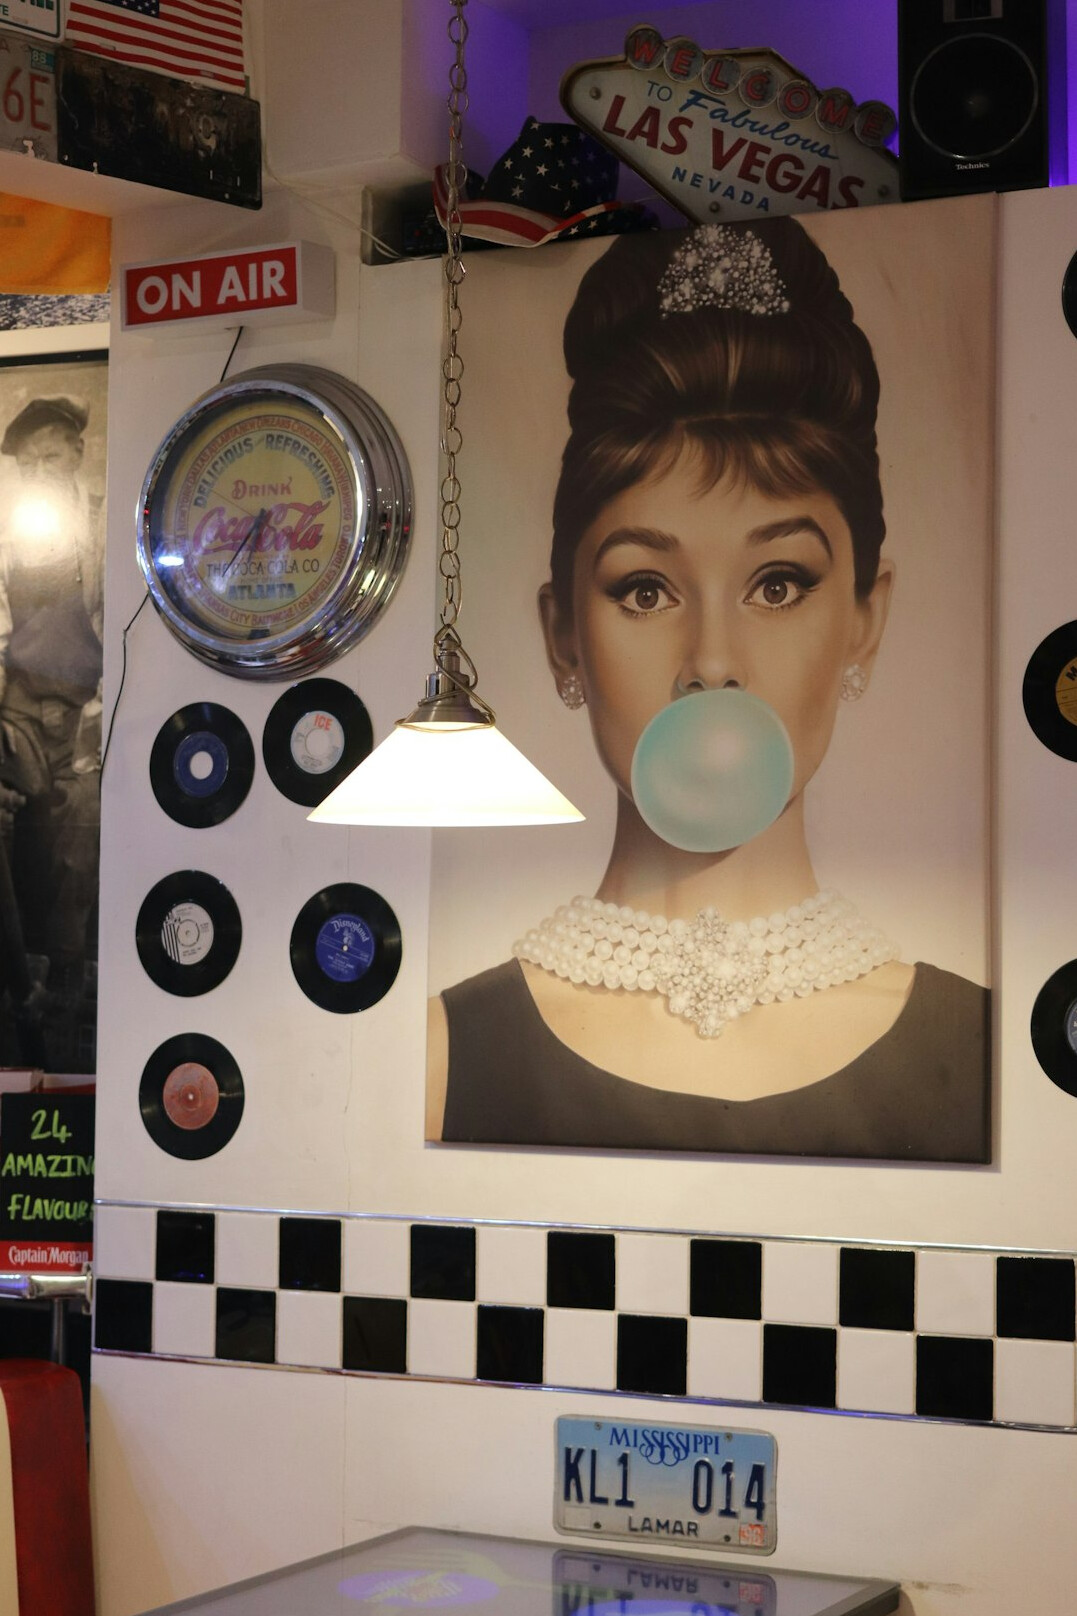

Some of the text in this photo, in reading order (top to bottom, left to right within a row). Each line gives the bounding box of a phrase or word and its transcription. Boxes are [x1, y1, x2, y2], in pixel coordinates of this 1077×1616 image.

[633, 35, 887, 142] WELCOME
[647, 80, 840, 160] TO Fabulous
[602, 95, 865, 210] LAS VEGAS
[954, 161, 991, 171] Technics
[672, 166, 770, 212] NEVADA
[136, 259, 288, 315] ON AIR
[195, 434, 335, 508] DELICIOUS REFRESHING
[231, 475, 294, 501] DRINK
[193, 501, 332, 555] CocaCola
[302, 557, 320, 573] CO
[314, 714, 334, 731] ICE
[330, 919, 370, 943] Disneyland
[30, 1109, 72, 1143] 24
[8, 1246, 89, 1267] Captain Morgan
[609, 1427, 720, 1467] MISSISSIPPI
[563, 1446, 766, 1521] KL1 014
[627, 1515, 699, 1537] LAMAR
